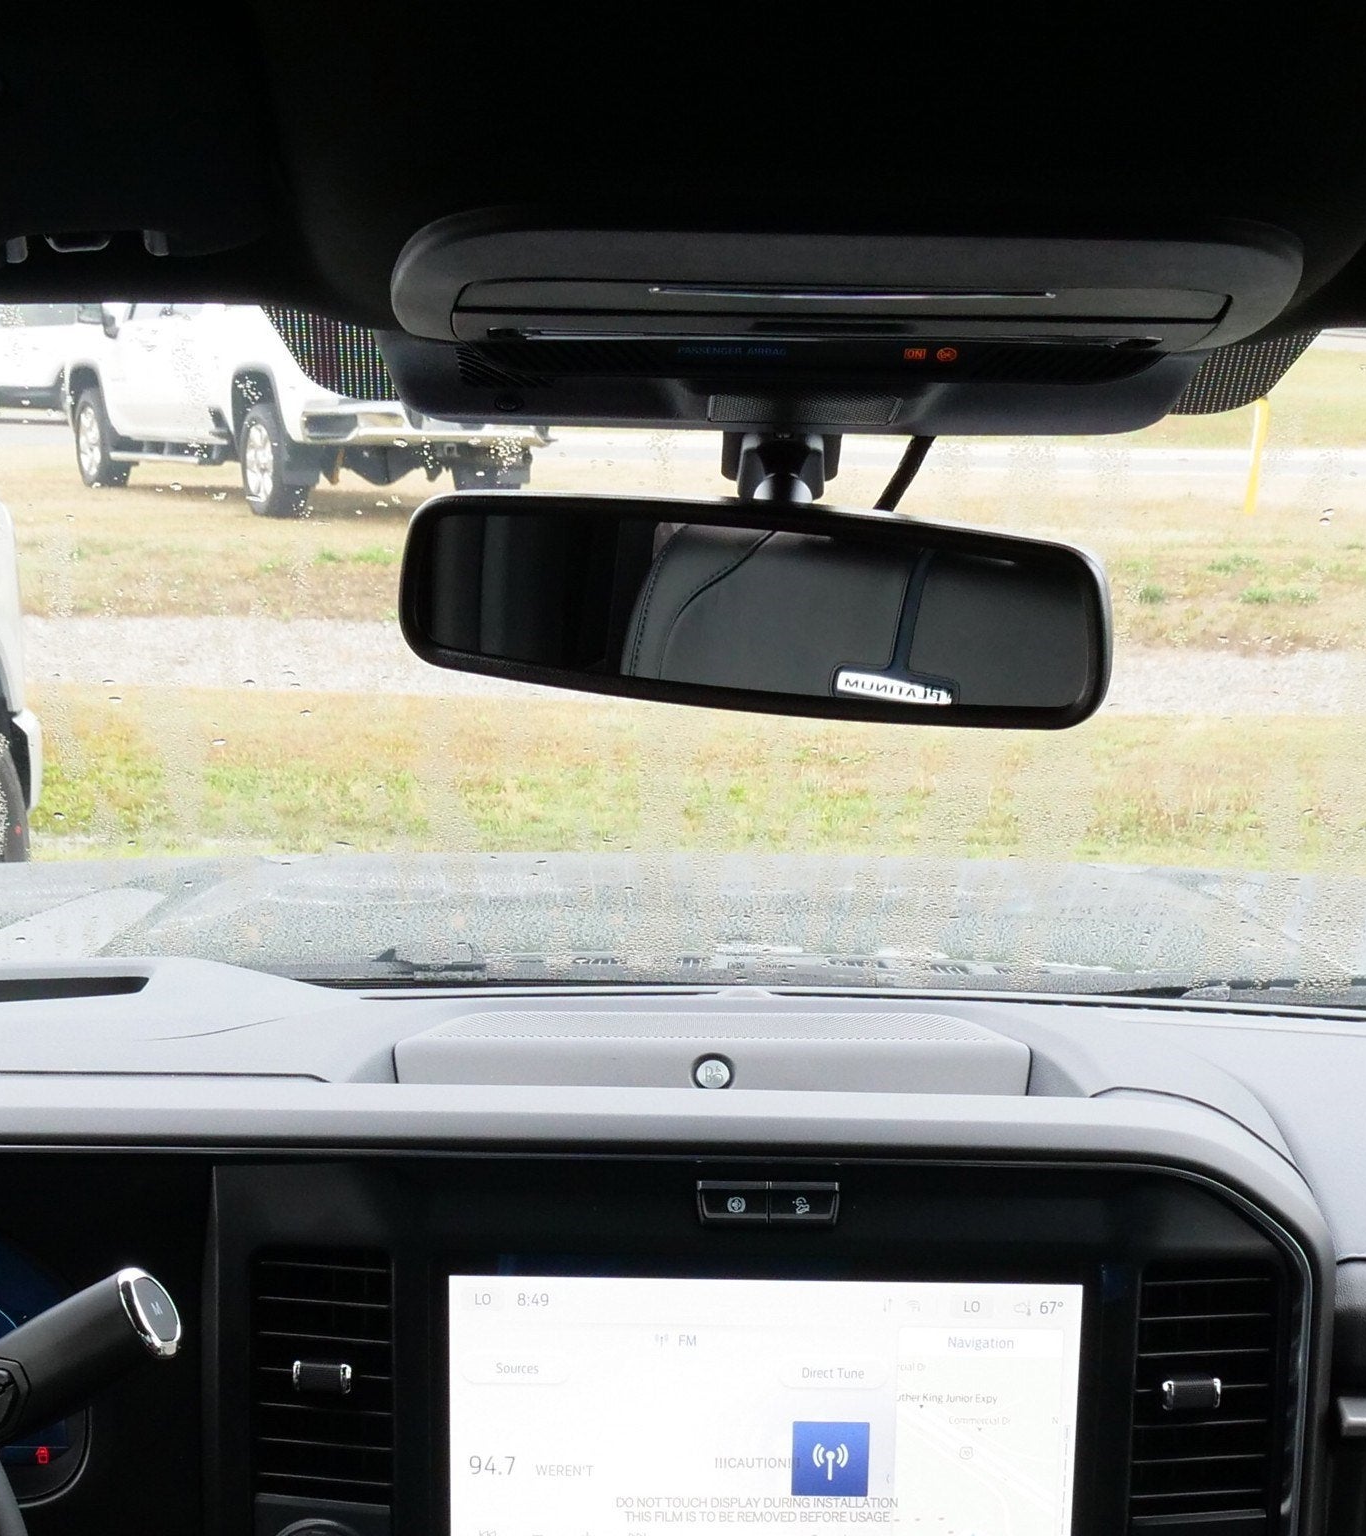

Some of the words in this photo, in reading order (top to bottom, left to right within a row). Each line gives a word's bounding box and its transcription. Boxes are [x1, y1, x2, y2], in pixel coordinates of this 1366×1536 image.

[907, 350, 923, 359] ON
[474, 1293, 492, 1306] LO
[516, 1293, 550, 1307] 8:49
[963, 1301, 981, 1313] LO
[1039, 1301, 1064, 1315] 67°
[678, 1335, 697, 1347] FM
[947, 1336, 1014, 1351] Navigation
[495, 1362, 539, 1375] Sources
[801, 1367, 833, 1379] Direct
[836, 1367, 865, 1379] Tune
[922, 1393, 944, 1406] King
[945, 1393, 973, 1404] Junior
[975, 1393, 998, 1406] Expy
[468, 1455, 516, 1476] 94.7
[615, 1497, 635, 1508] DO
[637, 1497, 663, 1508] NOT
[665, 1497, 708, 1508] TOUCH
[710, 1497, 761, 1509] DISPLAY
[763, 1497, 811, 1509] DURING
[813, 1497, 899, 1509] INSTALLATION
[624, 1511, 651, 1523] THIS
[654, 1511, 683, 1523] FILM
[685, 1511, 697, 1523] IS
[699, 1511, 717, 1523] TO
[719, 1511, 735, 1523] BE
[737, 1511, 797, 1523] REMOVED
[799, 1511, 847, 1523] BEFORE
[849, 1511, 890, 1523] USAGE
